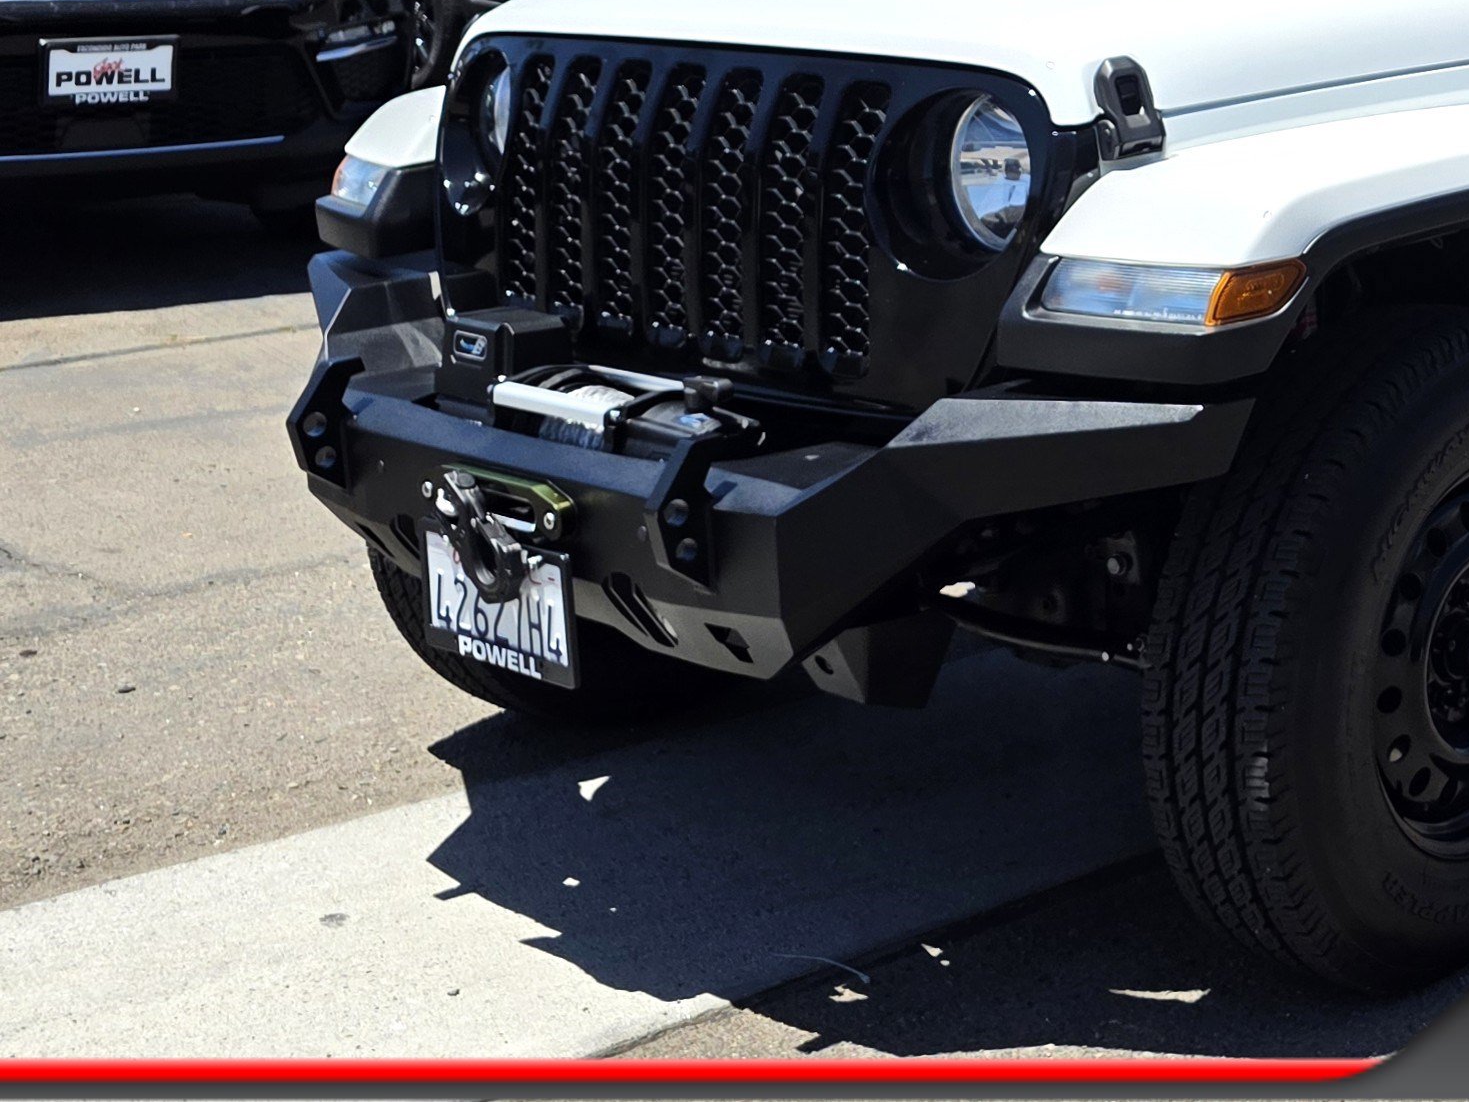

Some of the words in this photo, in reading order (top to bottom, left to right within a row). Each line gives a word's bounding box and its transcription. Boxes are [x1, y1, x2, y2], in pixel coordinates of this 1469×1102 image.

[56, 67, 166, 88] POWELL
[75, 90, 149, 105] POWELL
[457, 634, 542, 680] POWELL
